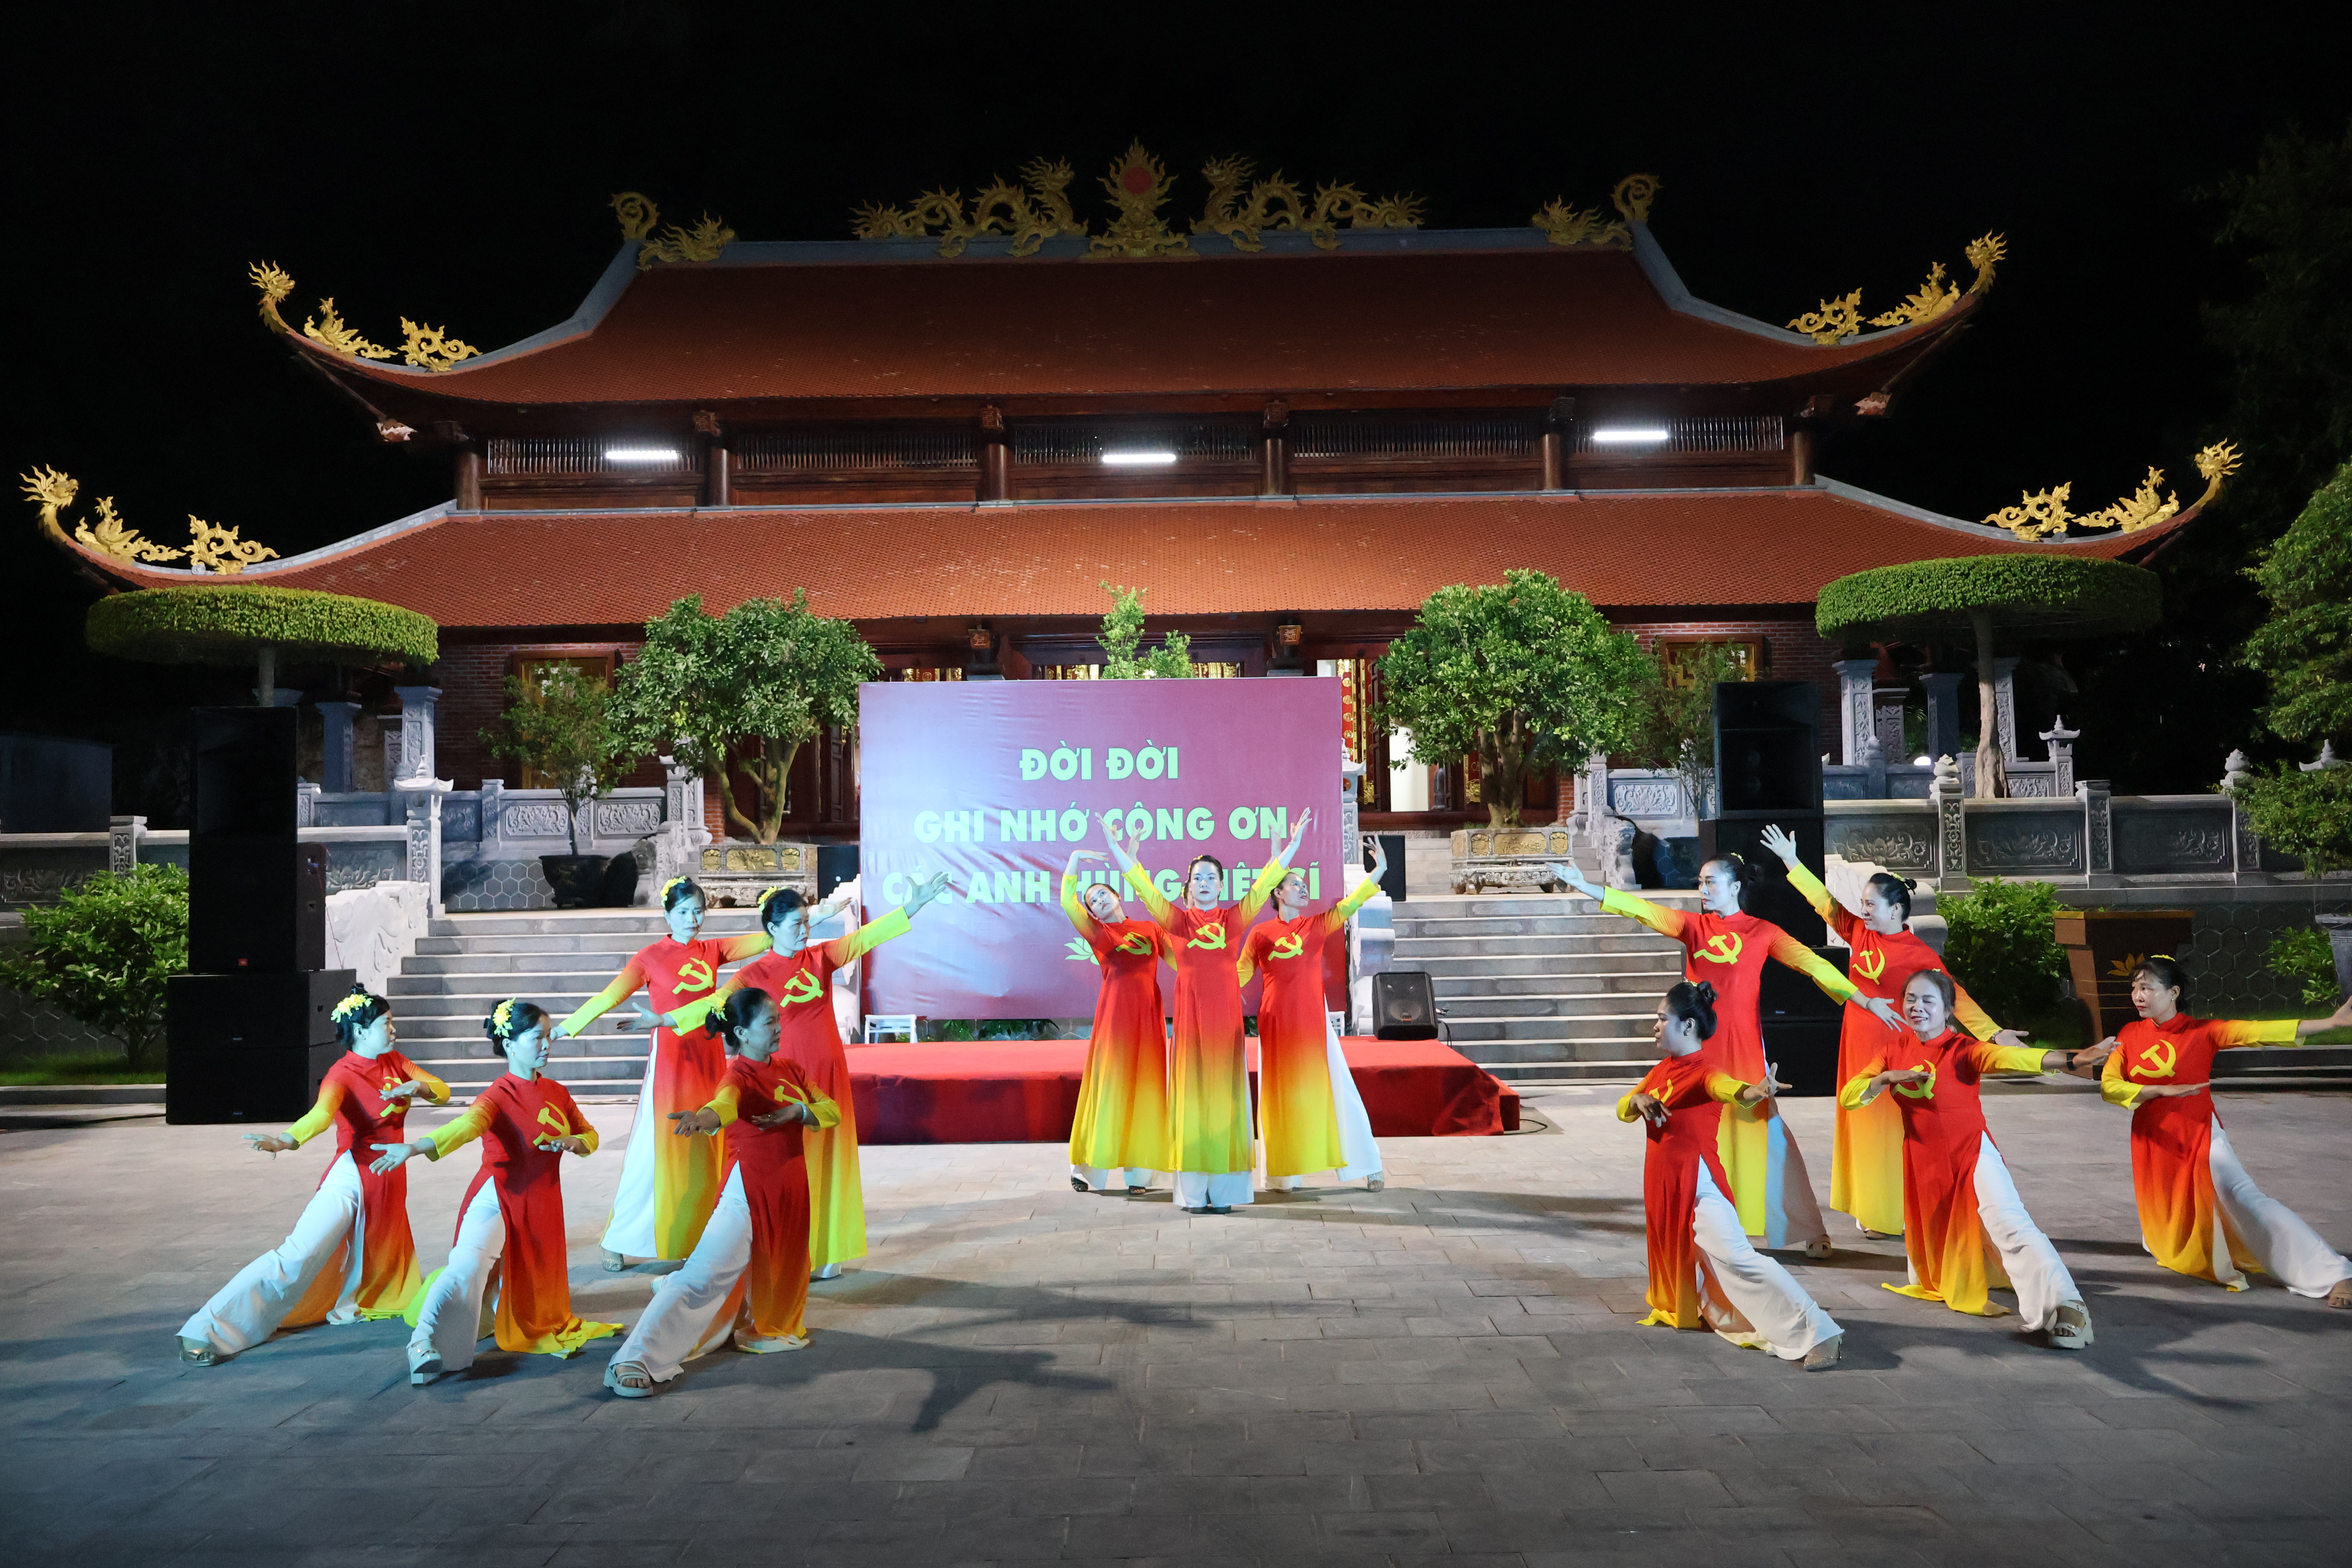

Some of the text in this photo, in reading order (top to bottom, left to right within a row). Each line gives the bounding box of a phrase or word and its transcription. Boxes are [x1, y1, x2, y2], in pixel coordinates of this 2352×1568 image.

[1019, 739, 1178, 781] ĐỜI ĐỜI
[914, 801, 1287, 843] GHI NHỚ CÔNG ƠN
[965, 871, 1051, 903] ANH
